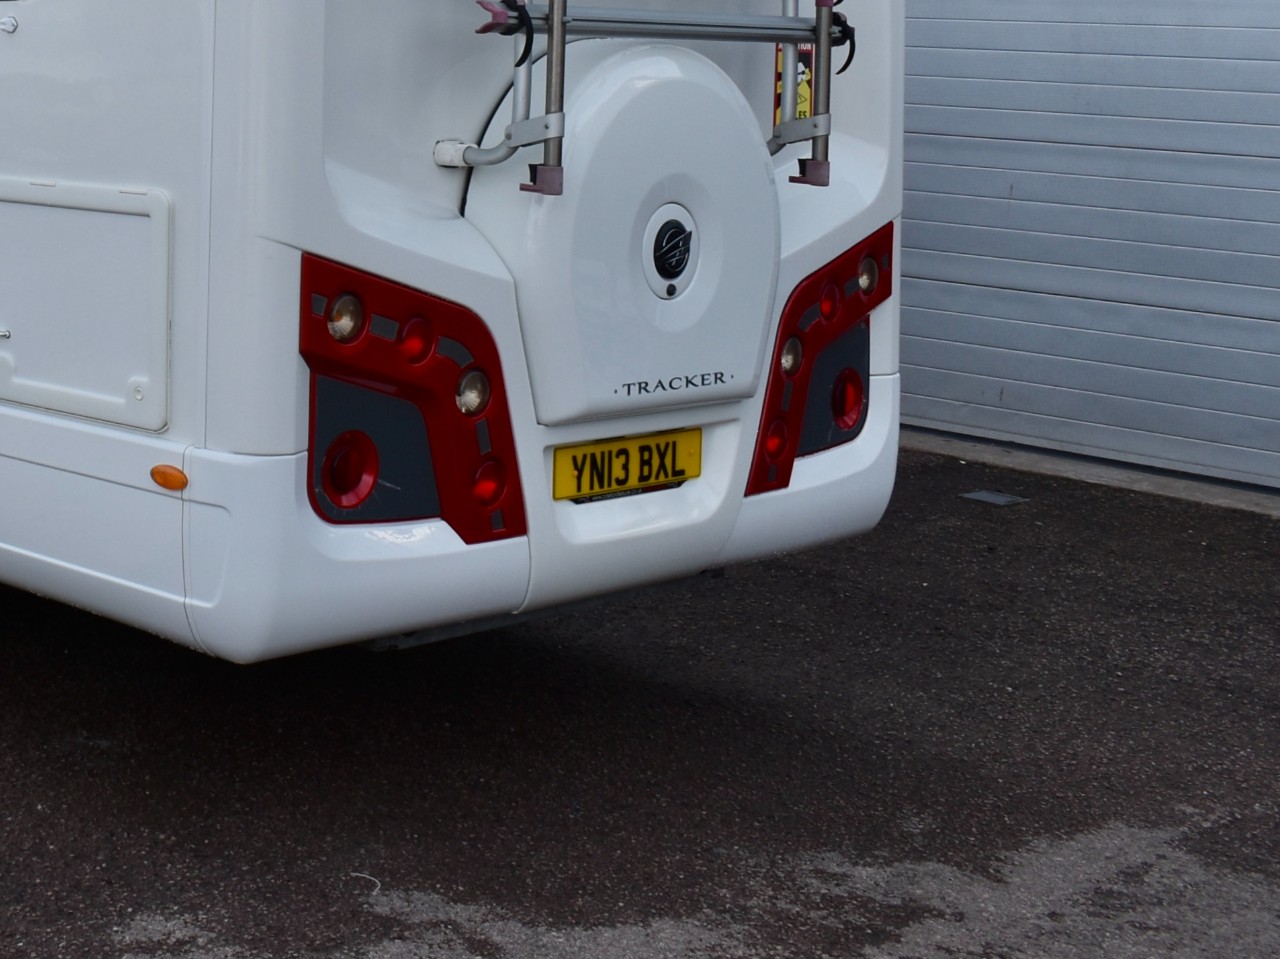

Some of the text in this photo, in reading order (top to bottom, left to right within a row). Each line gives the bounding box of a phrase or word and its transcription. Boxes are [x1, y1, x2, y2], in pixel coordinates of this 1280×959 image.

[621, 371, 727, 396] TRACKER
[572, 440, 686, 493] YN13 BXL
